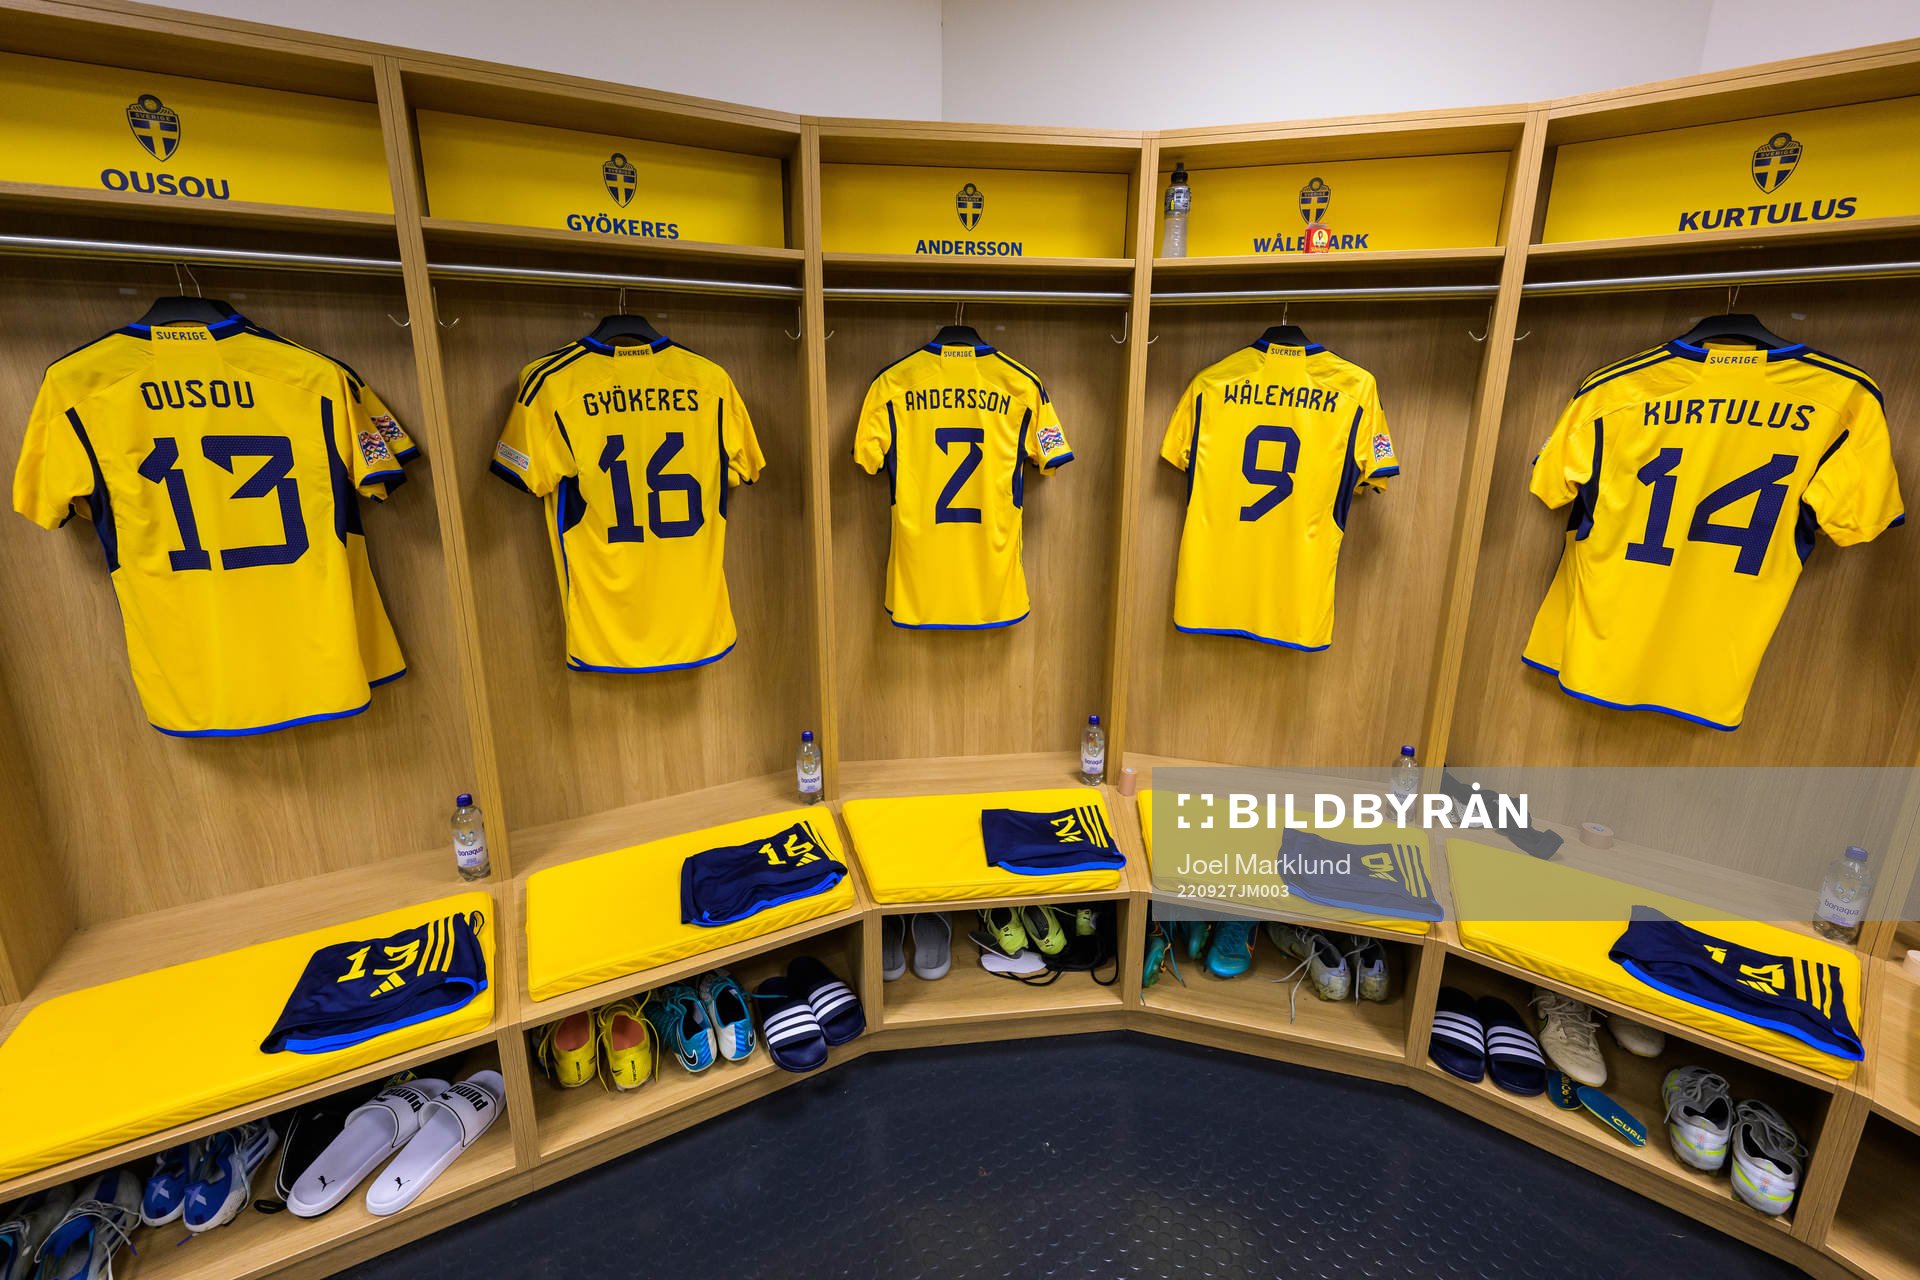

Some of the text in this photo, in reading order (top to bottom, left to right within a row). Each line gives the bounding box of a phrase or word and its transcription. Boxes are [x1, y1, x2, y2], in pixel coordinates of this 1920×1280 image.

[1760, 149, 1795, 157] SVERIGE
[101, 168, 230, 200] OUSOU
[567, 213, 680, 240] GYÖKERES
[1678, 197, 1857, 231] KURTULUS
[915, 239, 1023, 256] ANDERSSON
[1253, 232, 1369, 252] WÅLEARK
[156, 330, 208, 341] SVERIGE
[617, 348, 650, 357] SVERIGE
[943, 350, 973, 358] SVERIGE
[1270, 348, 1301, 357] SVERIGE
[1709, 355, 1760, 365] SVERIGE
[140, 379, 255, 410] OUSOU
[583, 385, 699, 417] GYÖKERES
[905, 388, 1011, 415] ANDERSSON
[1224, 379, 1340, 413] WÅLEMARK
[1644, 398, 1816, 431] KURTULUS
[598, 432, 705, 543] 16
[935, 427, 985, 524] 2
[1239, 424, 1301, 522] 9
[138, 435, 310, 571] 13
[1624, 447, 1800, 576] 14
[457, 846, 483, 857] bonaqua
[1824, 899, 1860, 916] bonaqua
[337, 938, 421, 984] 13
